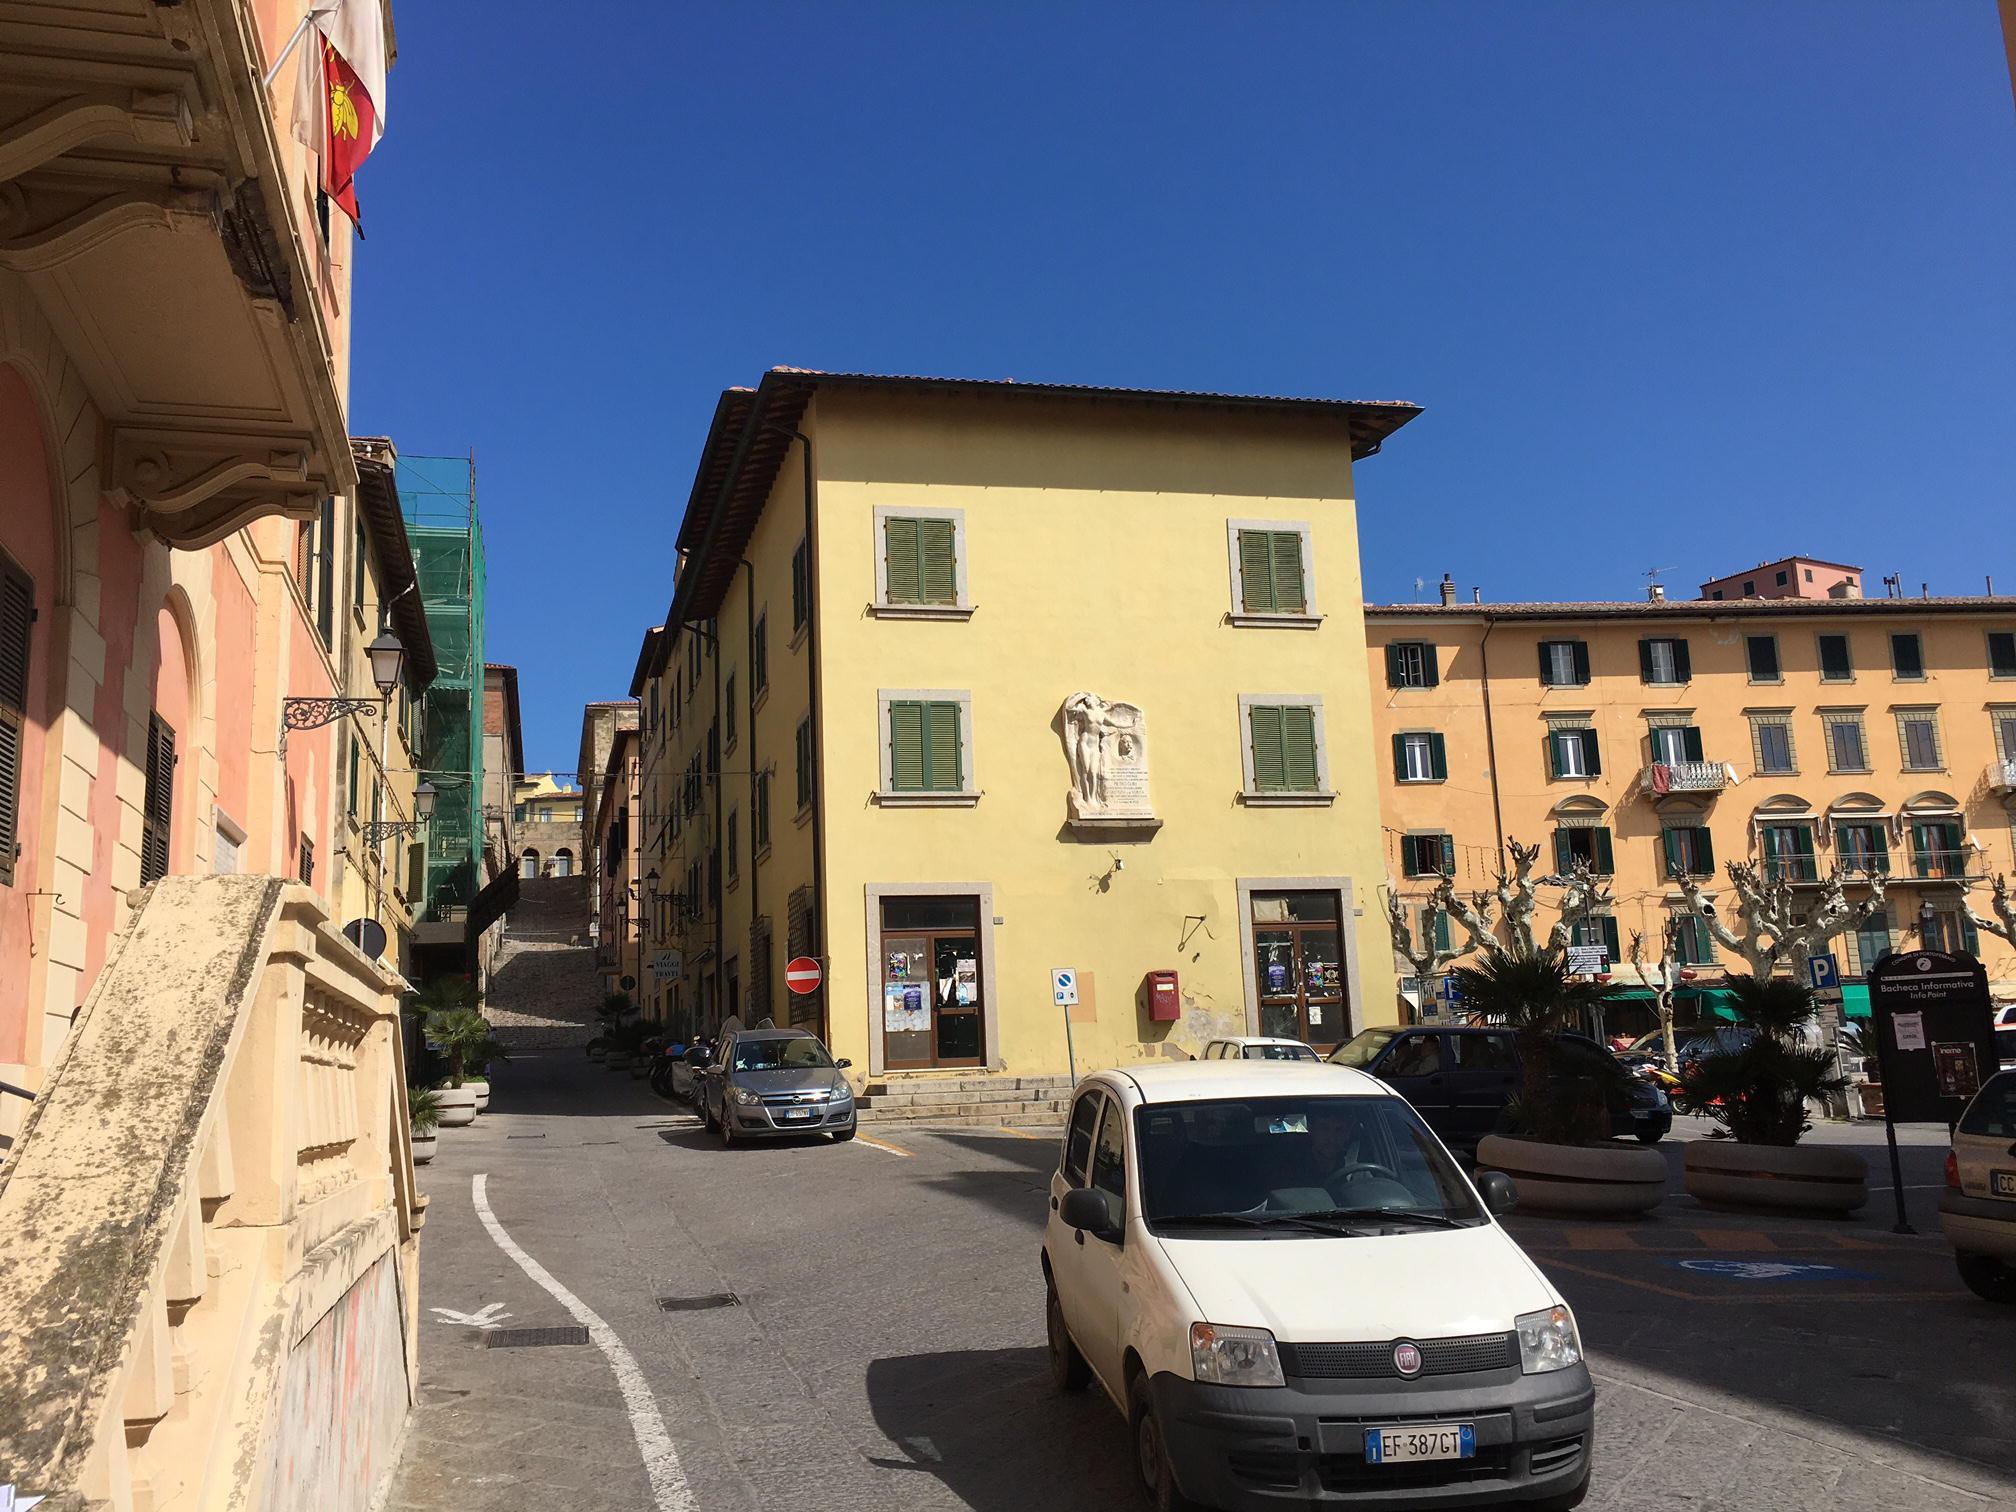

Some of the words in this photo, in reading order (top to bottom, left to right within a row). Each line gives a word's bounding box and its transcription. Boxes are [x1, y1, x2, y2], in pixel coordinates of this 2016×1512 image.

[1812, 958, 1829, 986] P
[1880, 984, 1919, 993] Bacheca
[1920, 980, 1975, 991] Informativa
[1910, 991, 1927, 999] Info
[1399, 1351, 1416, 1367] FIAT
[1382, 1434, 1402, 1458] EF
[1408, 1432, 1459, 1456] 387GT
